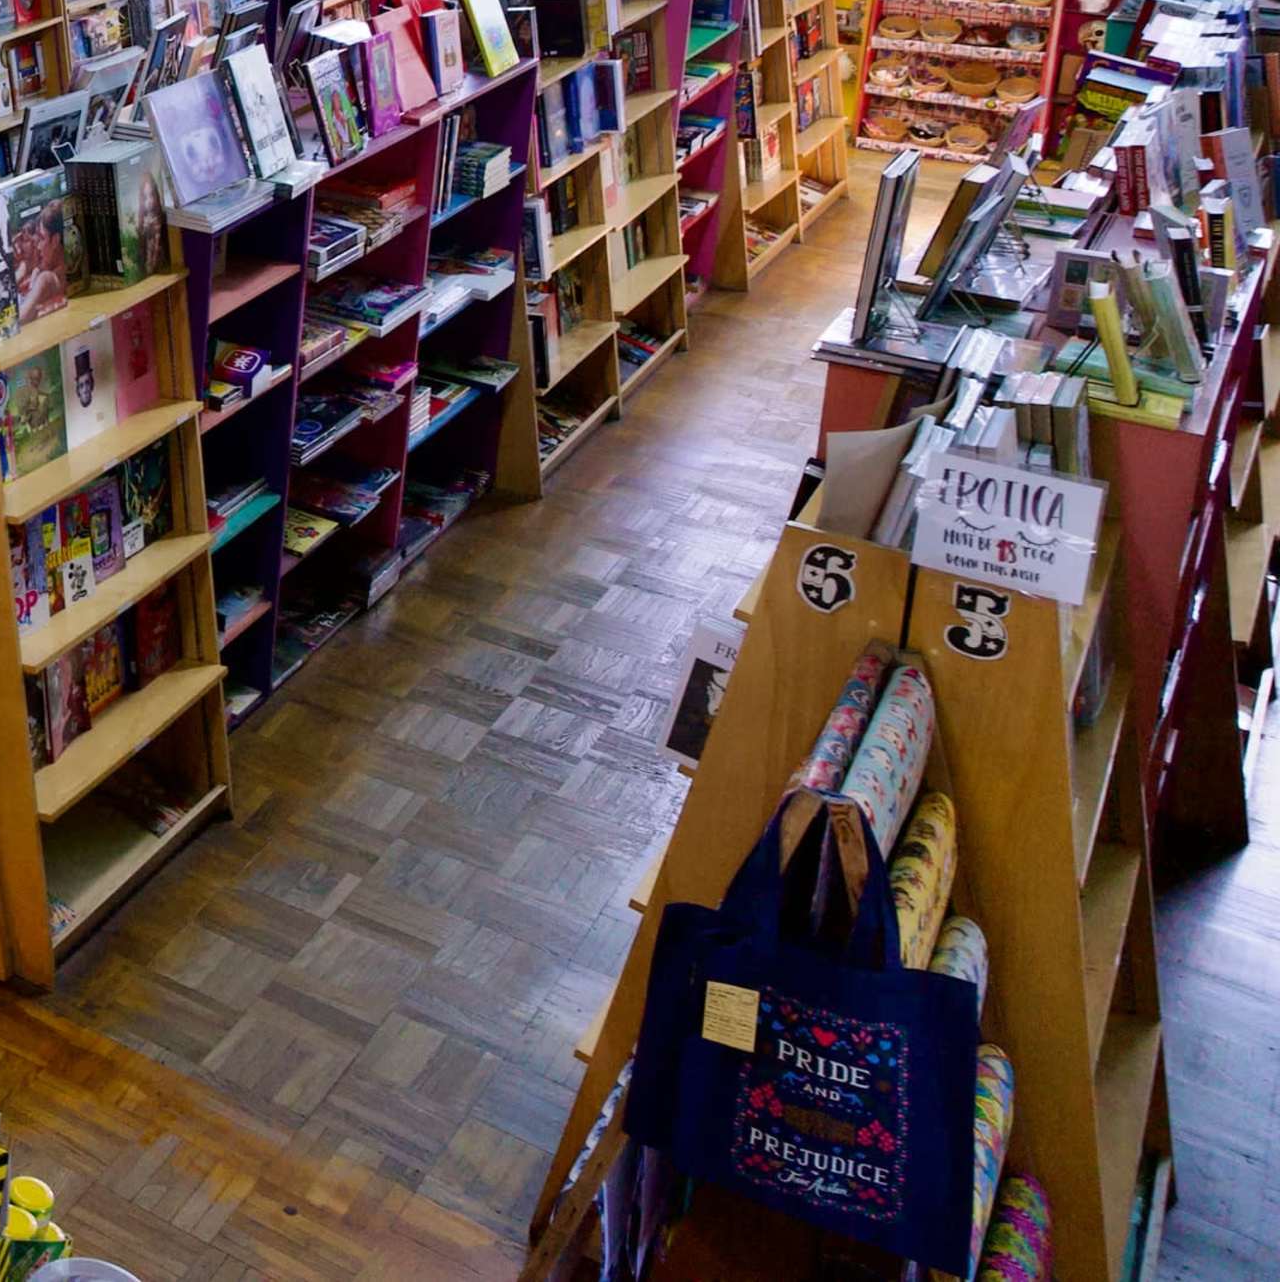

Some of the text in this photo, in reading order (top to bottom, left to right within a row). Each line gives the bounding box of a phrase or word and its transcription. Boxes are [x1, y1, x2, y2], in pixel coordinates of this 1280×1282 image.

[938, 467, 1065, 530] EROTICA
[942, 528, 974, 548] MUST
[978, 536, 992, 551] BE
[996, 539, 1017, 564] 18
[945, 552, 1041, 583] DOWN THIS AISLE
[801, 545, 857, 611] 6
[946, 582, 1009, 659] 5
[777, 1038, 872, 1089] PRIDE
[803, 1082, 841, 1102] AND
[749, 1126, 890, 1186] PREJUDICE
